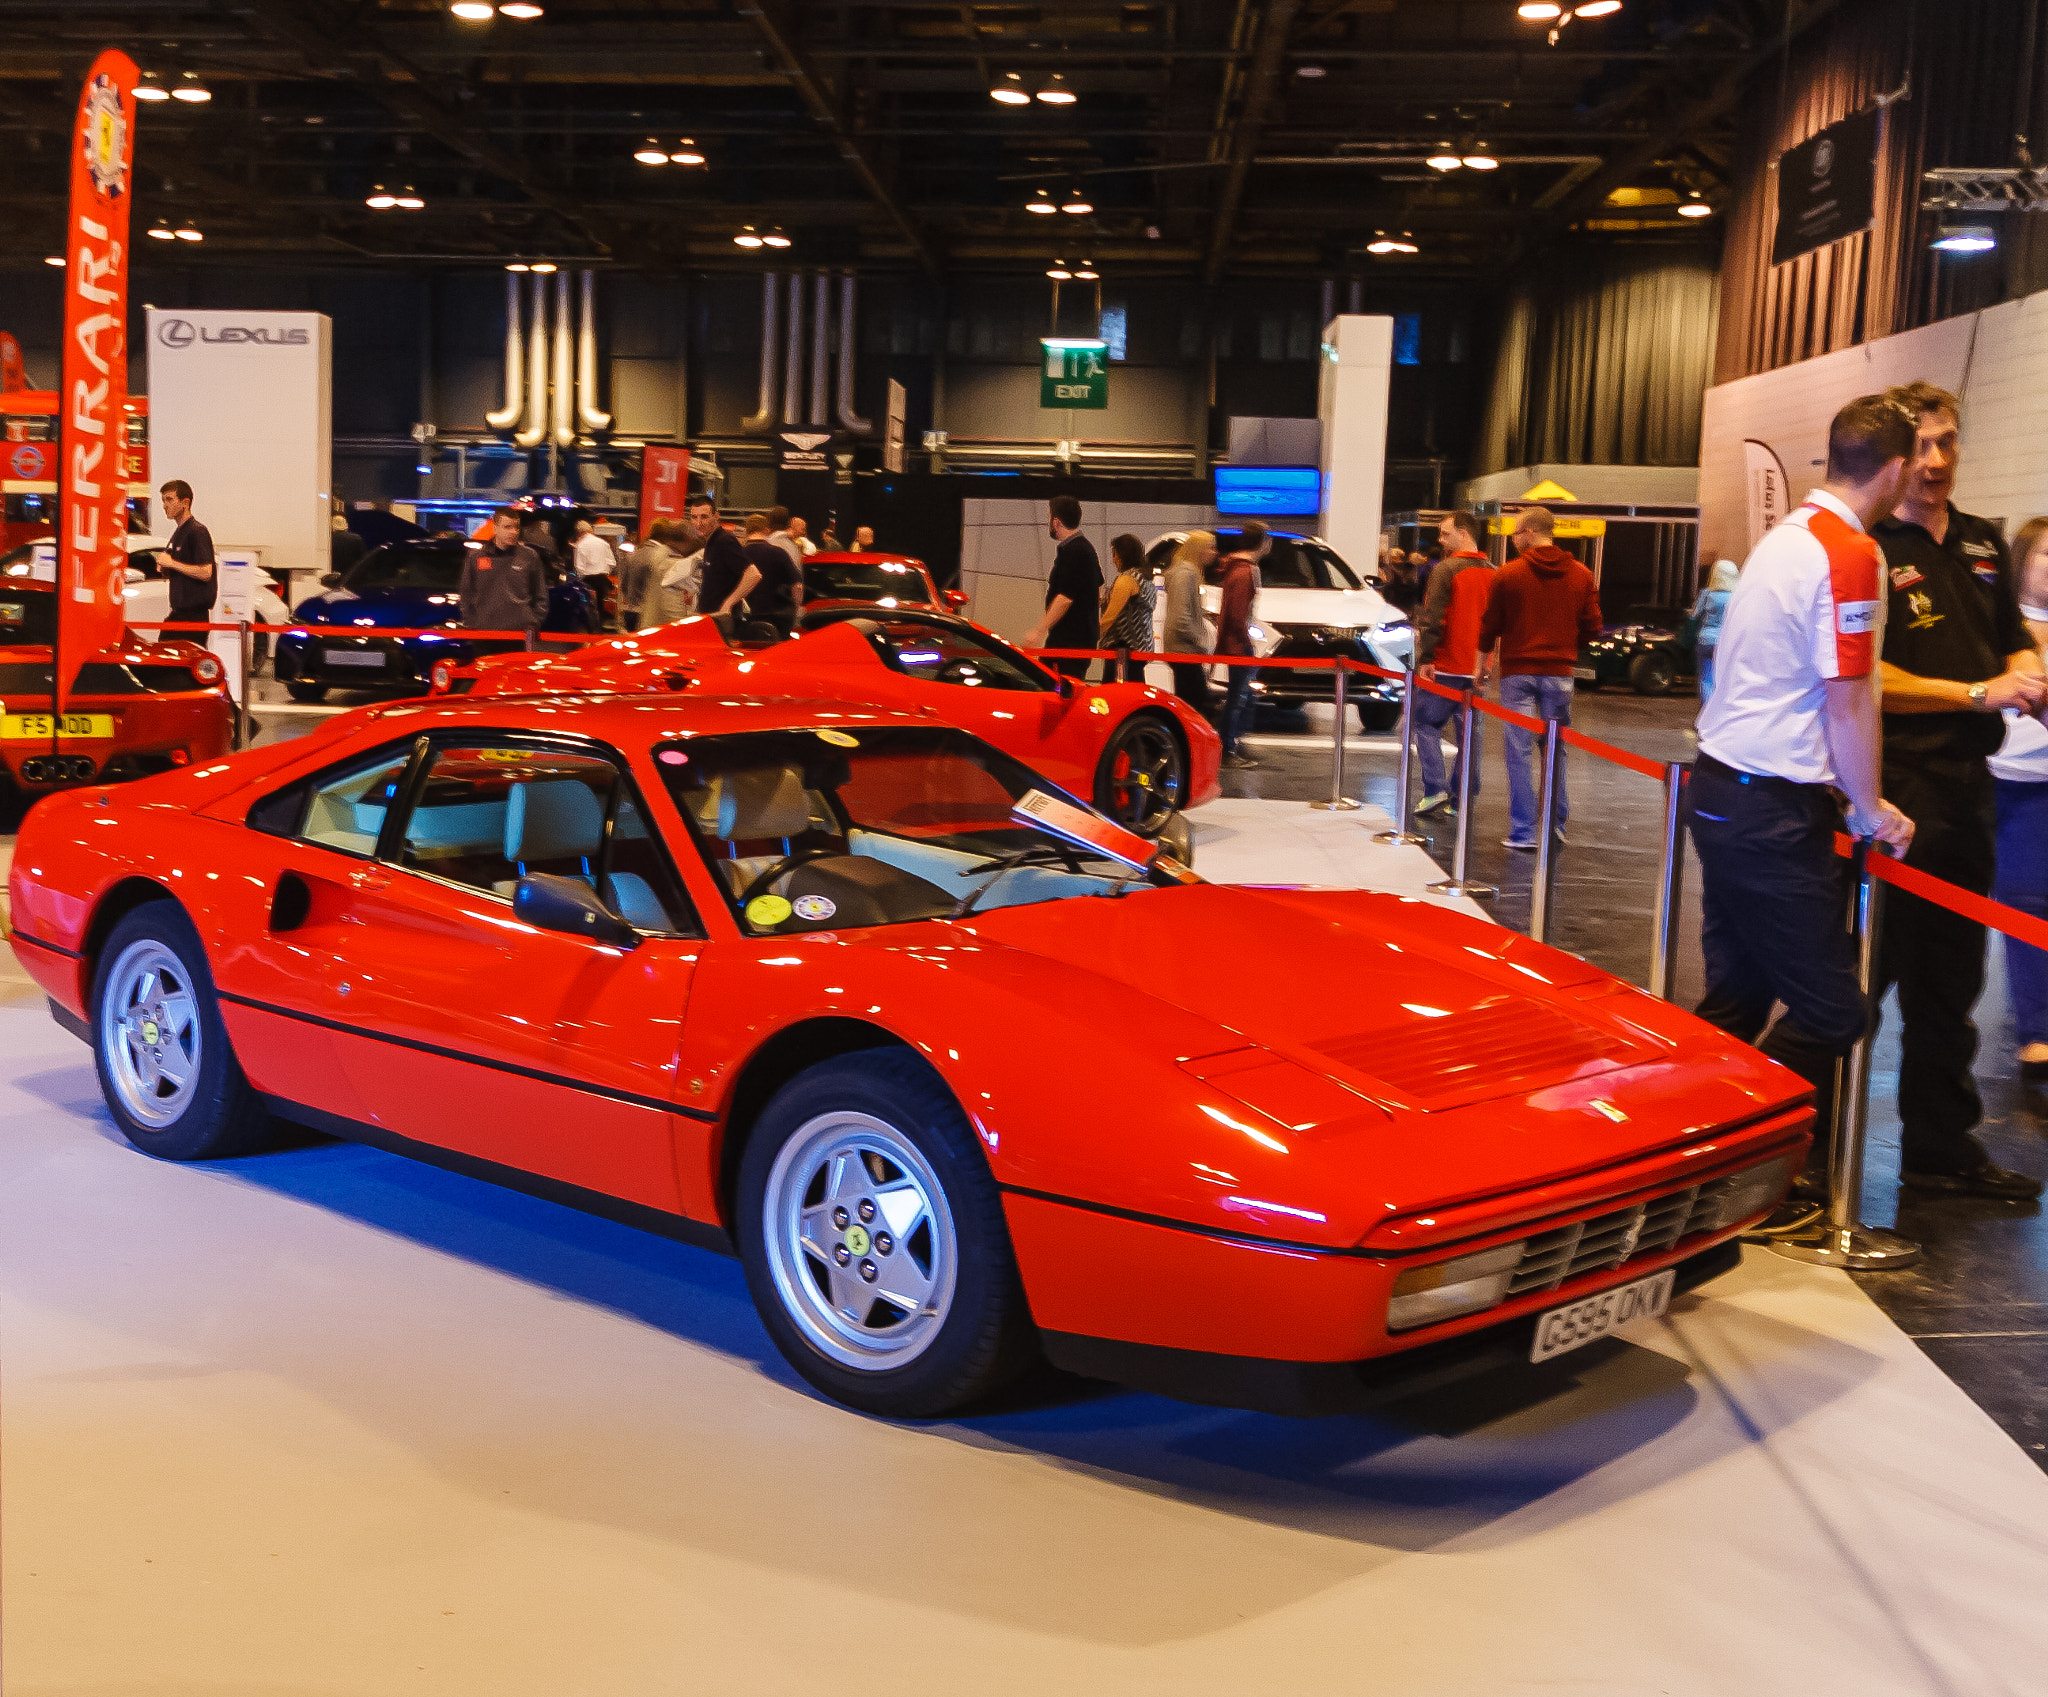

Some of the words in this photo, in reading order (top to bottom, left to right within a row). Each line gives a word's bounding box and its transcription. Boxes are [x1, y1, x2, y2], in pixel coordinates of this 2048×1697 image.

[201, 327, 309, 345] LEXUS
[1055, 384, 1091, 399] EXIT
[73, 215, 119, 604] FERRARI
